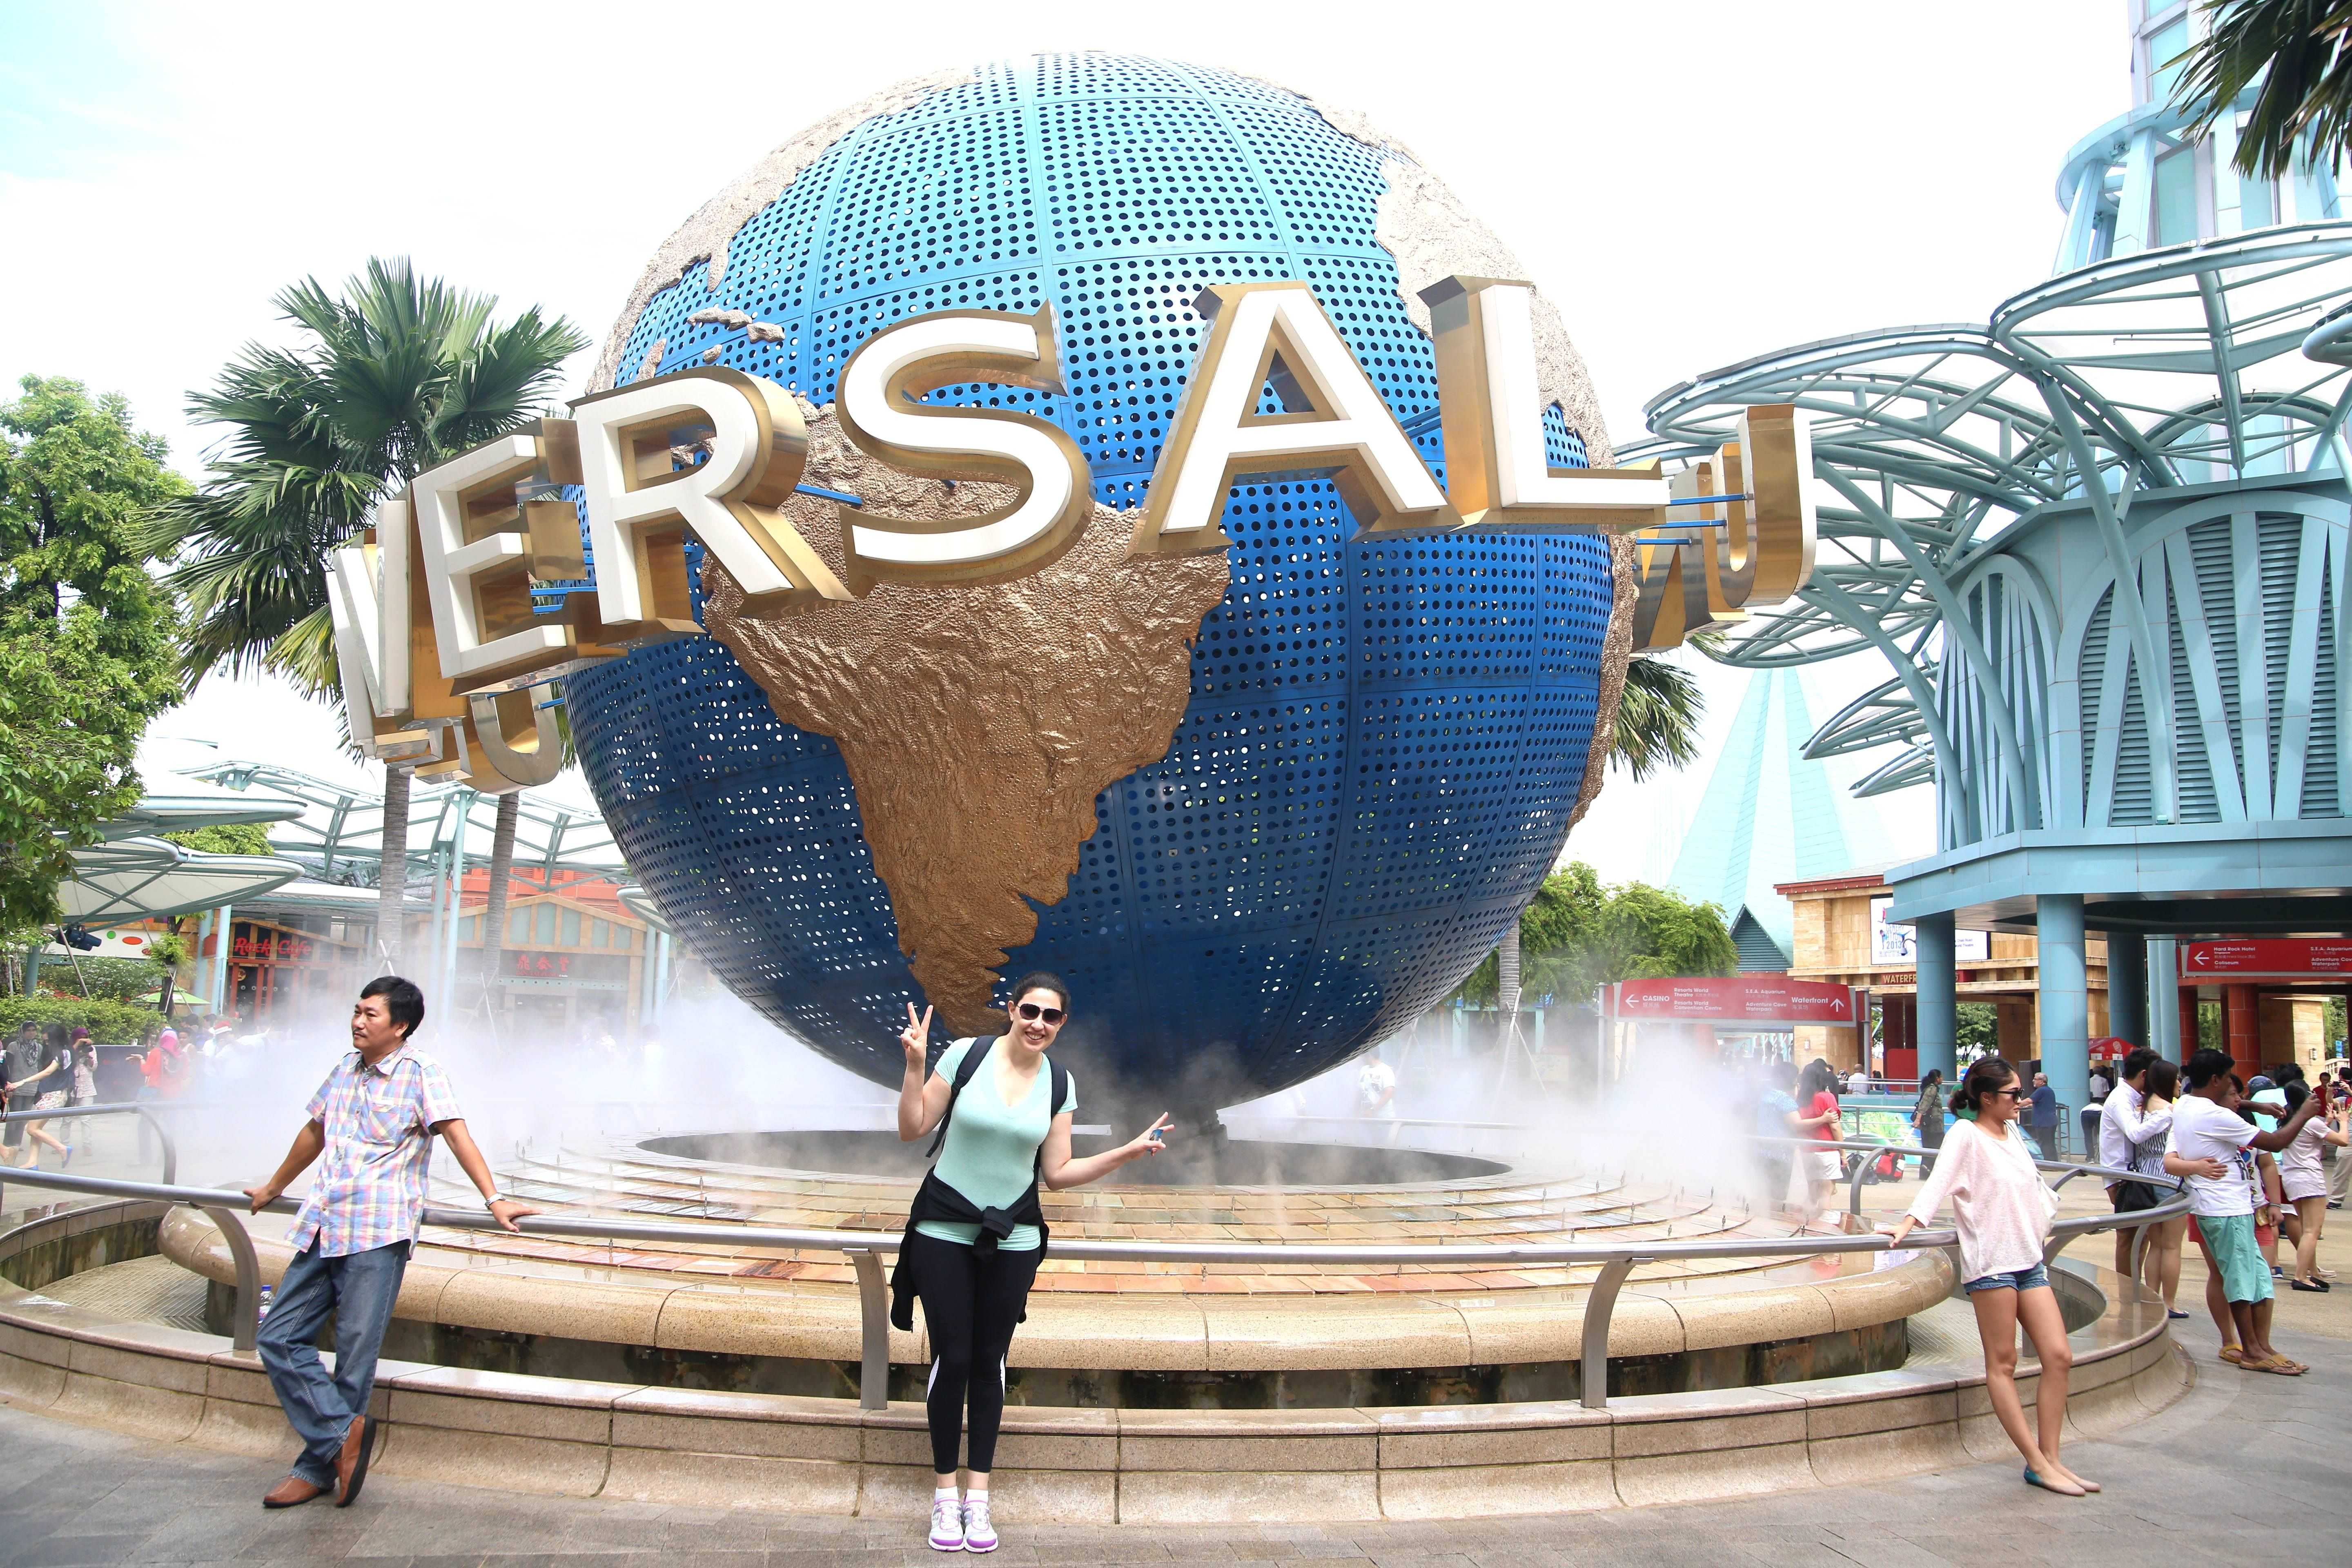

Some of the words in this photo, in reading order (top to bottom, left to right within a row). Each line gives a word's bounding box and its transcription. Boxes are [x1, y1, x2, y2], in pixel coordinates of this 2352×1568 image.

[234, 937, 272, 956] Rock
[278, 940, 312, 958] Cafe
[1886, 941, 1902, 949] 2013
